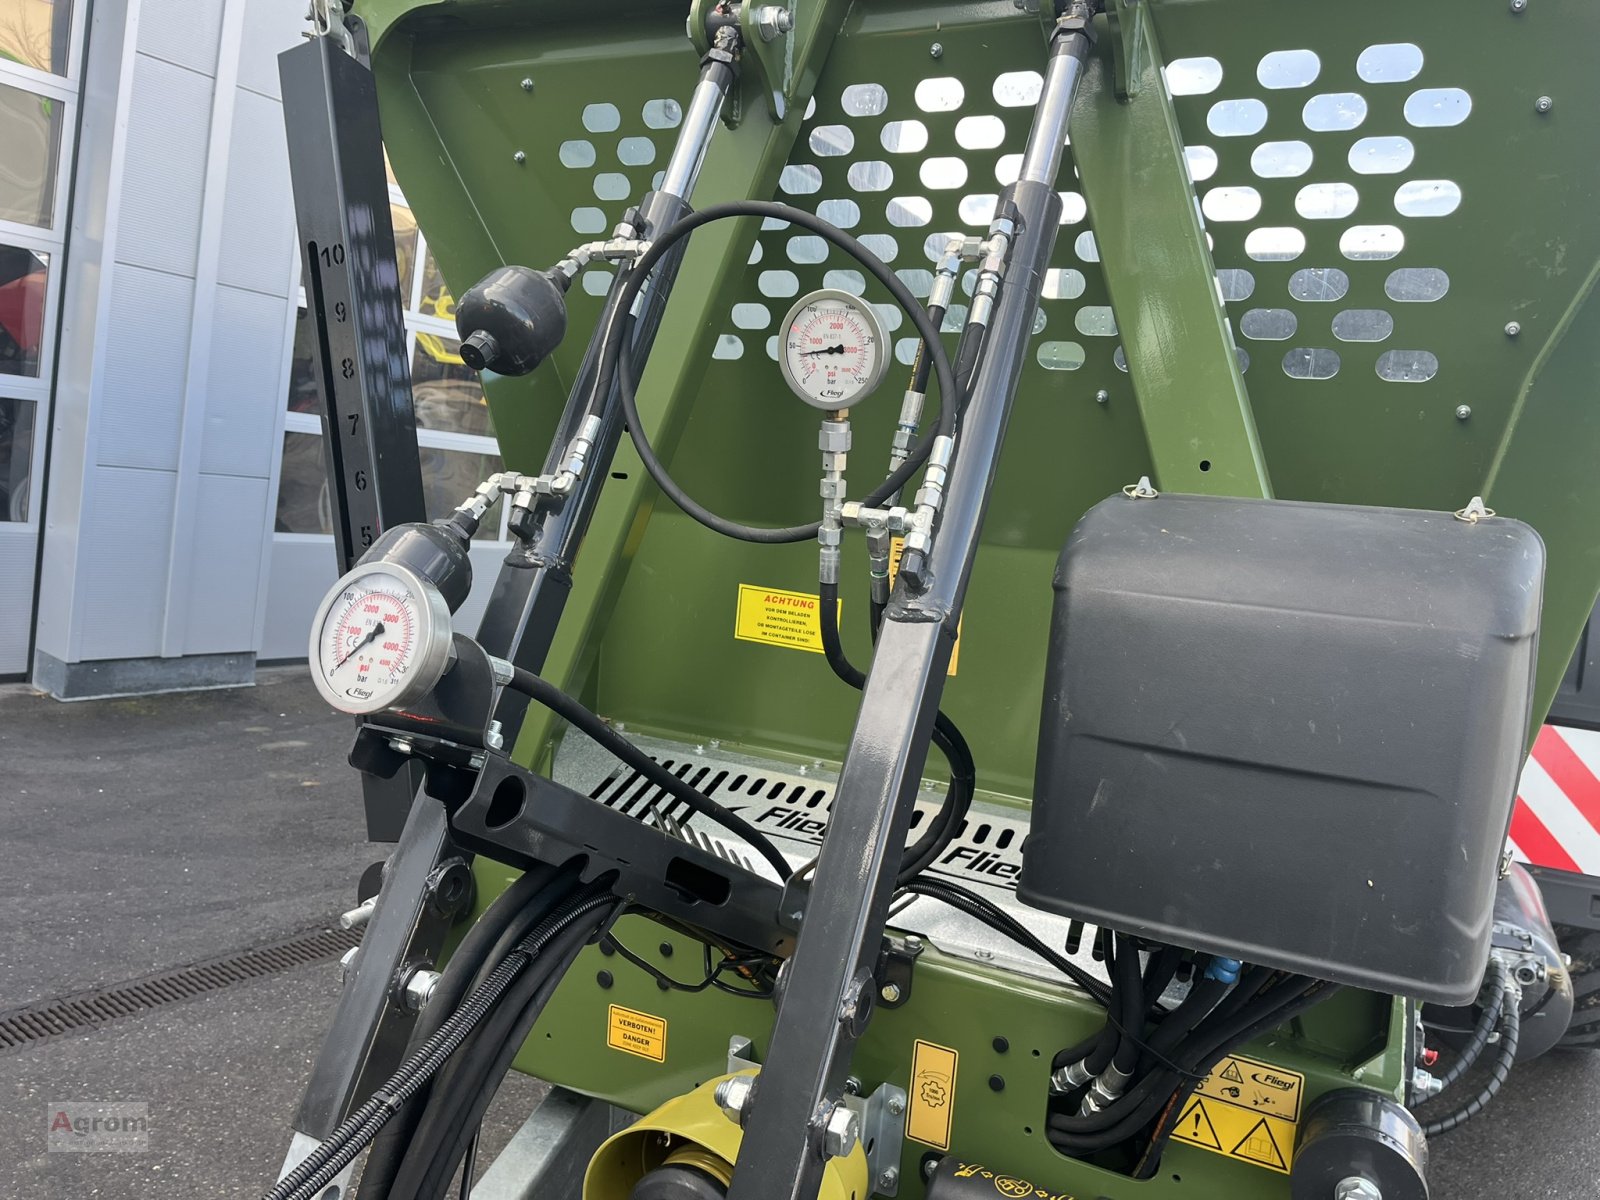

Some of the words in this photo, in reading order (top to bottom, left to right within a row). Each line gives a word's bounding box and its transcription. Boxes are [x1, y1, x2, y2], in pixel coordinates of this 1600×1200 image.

[321, 243, 345, 268] 10
[336, 301, 346, 323] 9
[829, 322, 844, 330] 2000
[867, 336, 875, 344] 20
[342, 357, 354, 380] 8
[347, 414, 359, 436] 7
[355, 470, 367, 491] 6
[360, 525, 372, 548] 5
[344, 592, 354, 600] 100
[764, 595, 815, 609] ACHTUNG
[364, 604, 379, 614] 2000
[788, 610, 810, 618] BELADEN
[382, 613, 399, 623] 3000
[347, 626, 362, 635] 1000
[765, 624, 802, 634] MONTAGETEILE
[768, 632, 796, 641] CONTAINER
[382, 642, 399, 651] 4000
[359, 664, 370, 672] psi
[357, 675, 368, 683] bar
[353, 688, 373, 700] Fliegl
[619, 1019, 656, 1034] VERBOTEN!
[623, 1033, 650, 1046] DANGER
[1264, 1074, 1296, 1092] Fliegl
